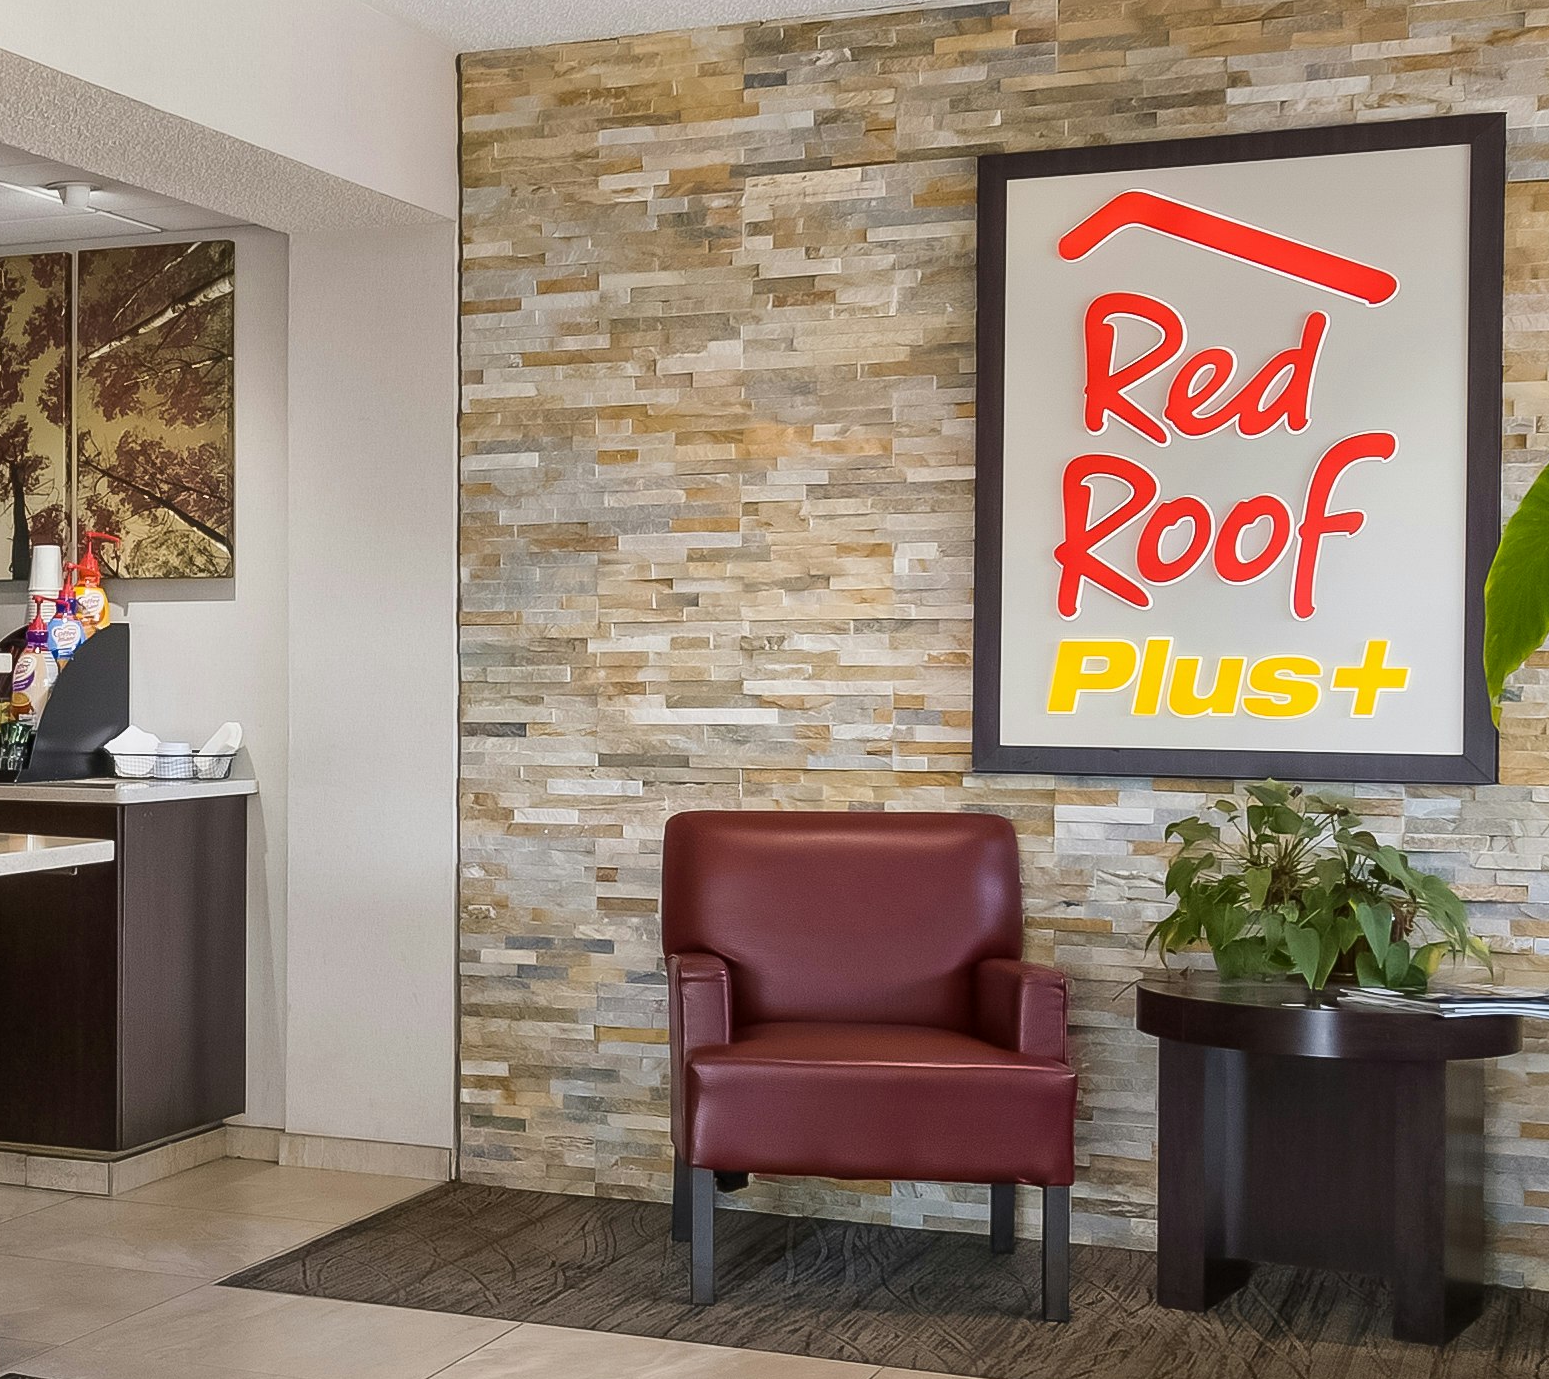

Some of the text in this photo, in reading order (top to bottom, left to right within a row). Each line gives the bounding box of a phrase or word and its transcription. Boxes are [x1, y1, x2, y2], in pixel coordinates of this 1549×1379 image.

[1082, 291, 1329, 446] Red
[1052, 430, 1399, 620] Roof
[1046, 637, 1410, 719] Plus+
